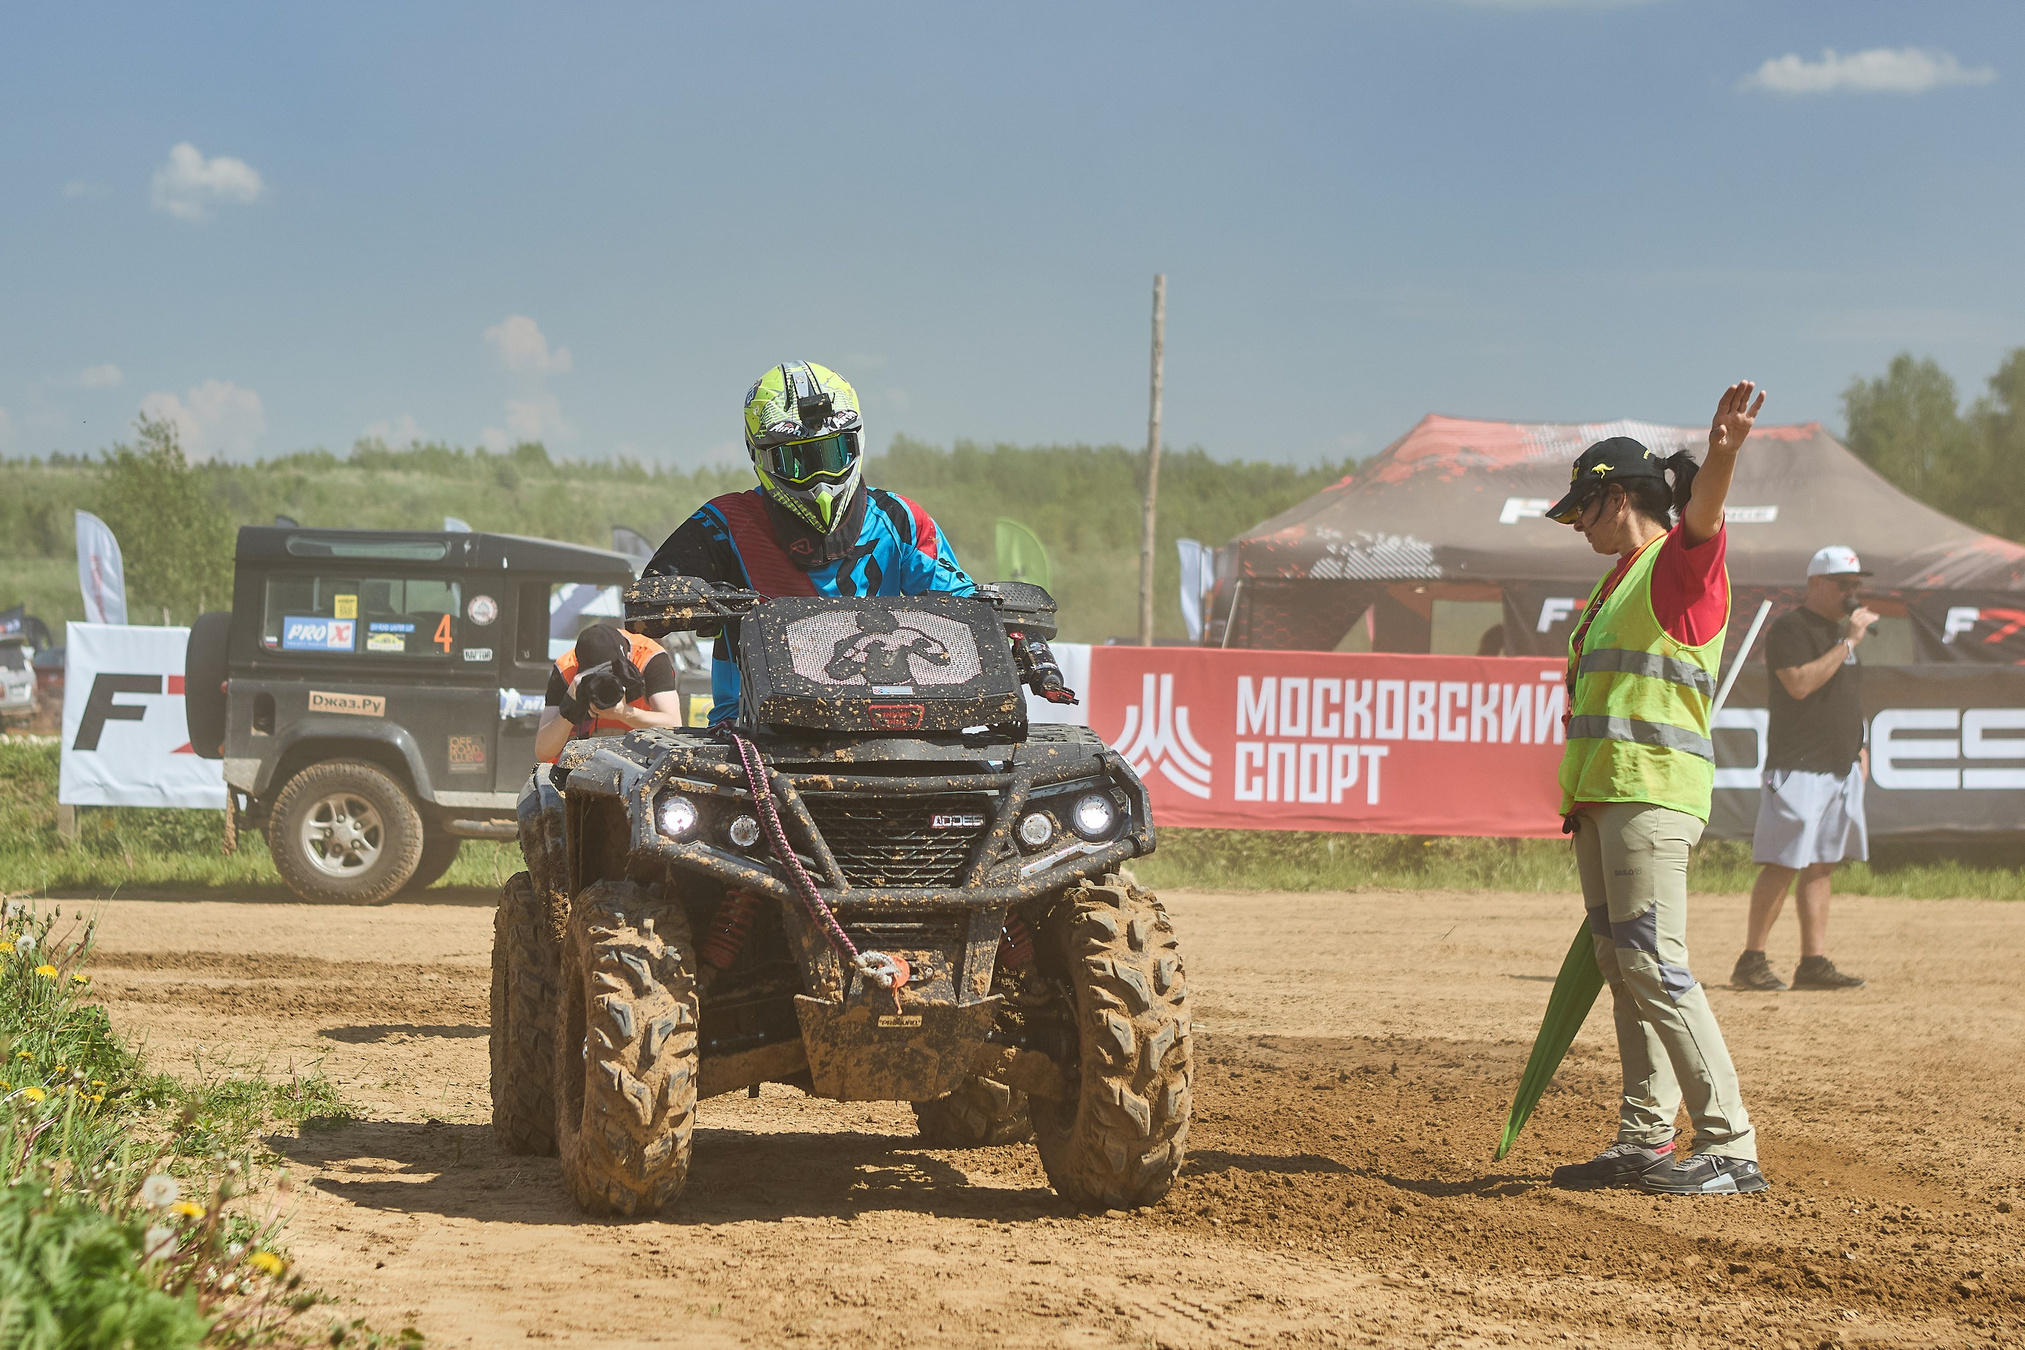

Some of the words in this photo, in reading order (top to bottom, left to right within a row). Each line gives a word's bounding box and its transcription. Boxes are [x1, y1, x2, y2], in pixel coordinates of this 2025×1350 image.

[769, 421, 801, 437] Airoh
[287, 624, 327, 642] PRO
[434, 613, 453, 653] 4
[1235, 671, 1567, 746] МОСКОВСКИЙ
[1234, 741, 1389, 805] СПОРТ
